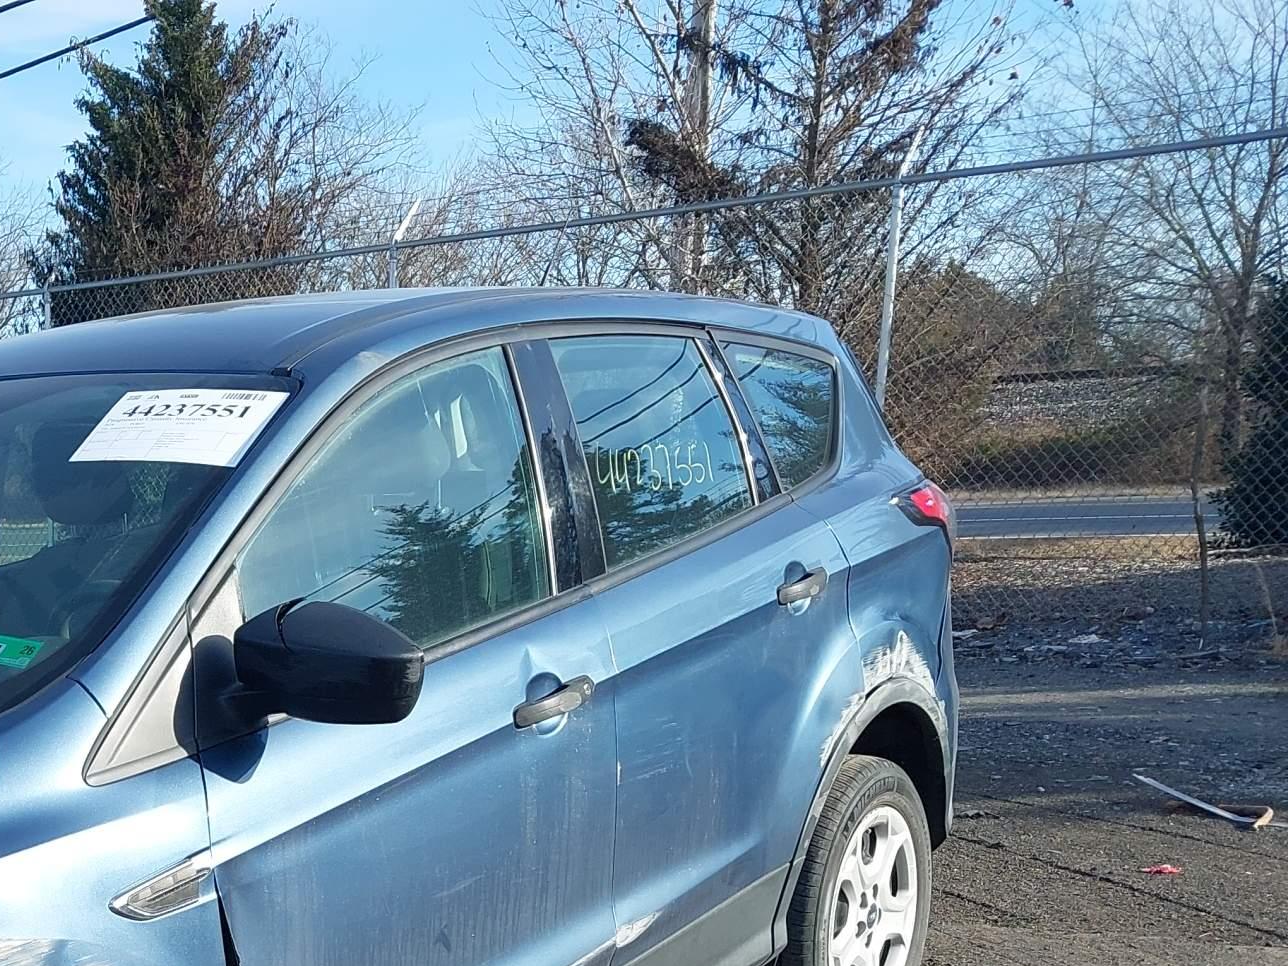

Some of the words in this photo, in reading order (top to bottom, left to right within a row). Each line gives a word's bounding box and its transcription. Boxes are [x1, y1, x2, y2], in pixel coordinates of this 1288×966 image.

[122, 403, 252, 418] 44237551
[595, 441, 714, 494] 44237551
[19, 645, 36, 656] 26
